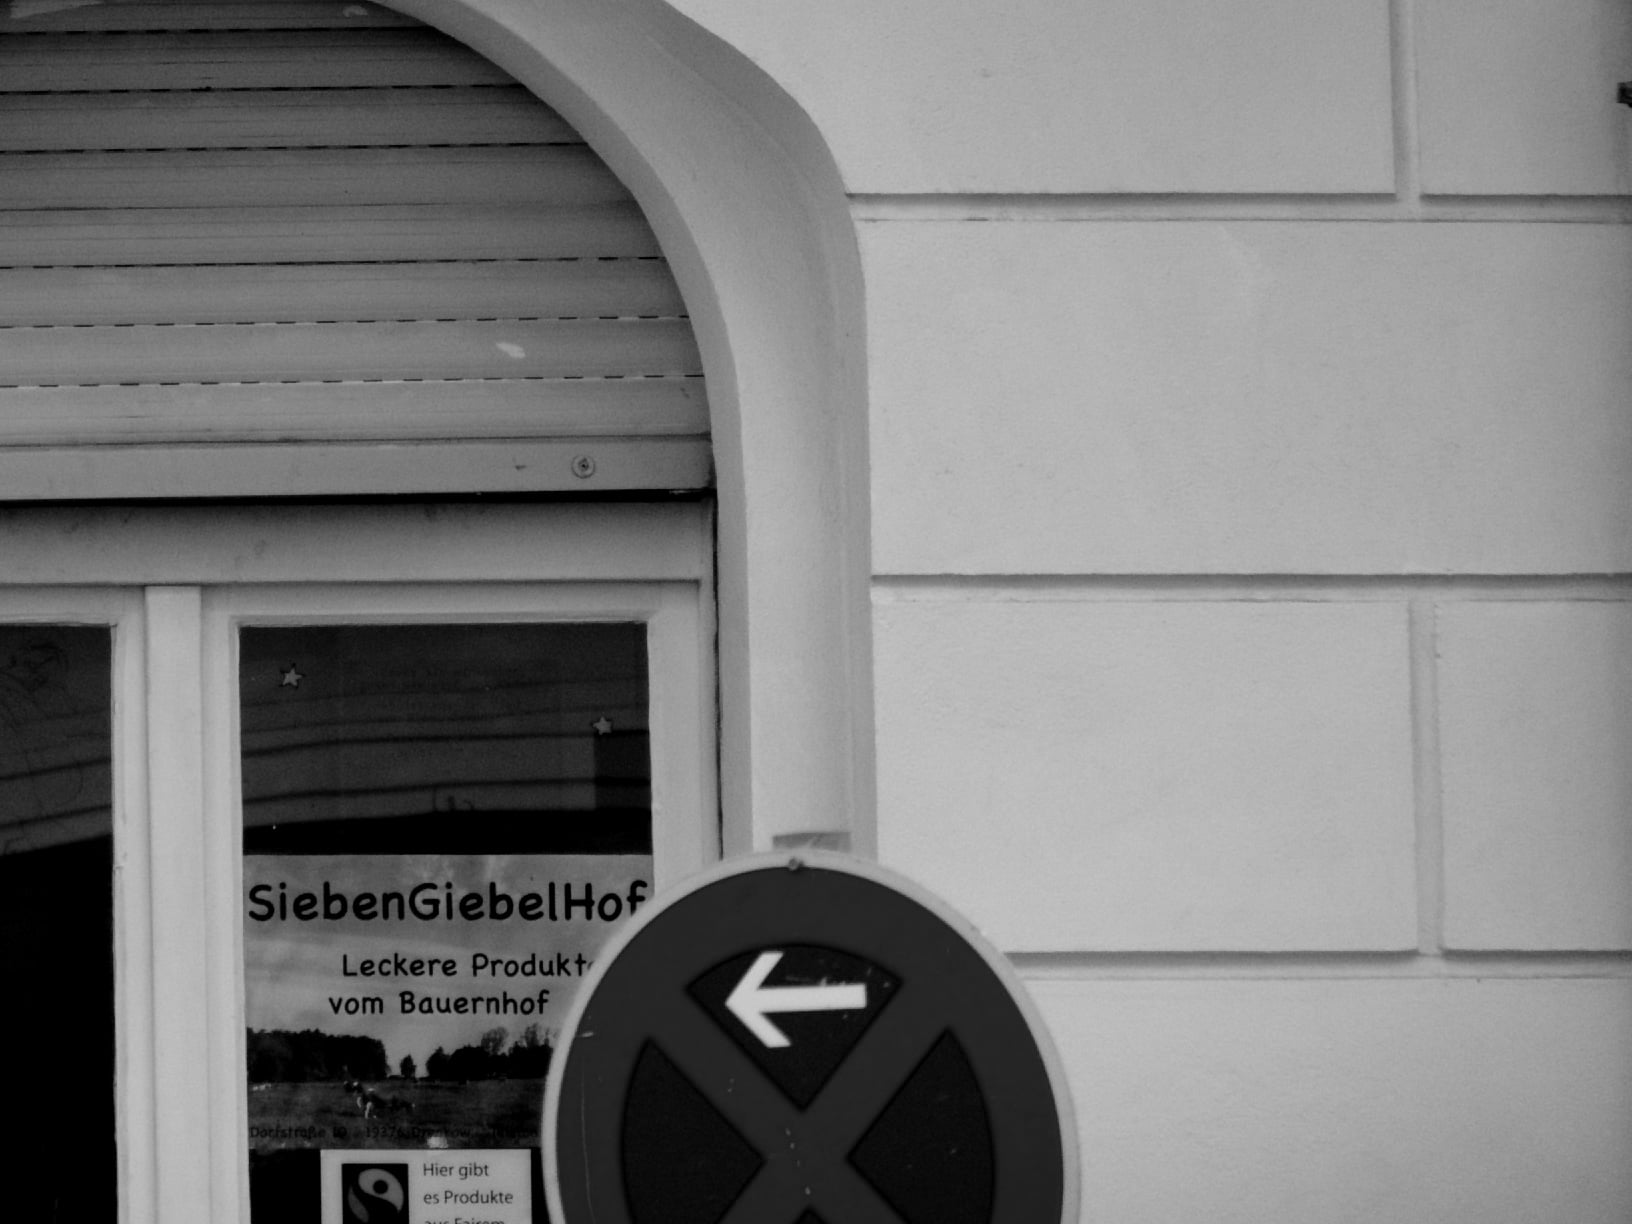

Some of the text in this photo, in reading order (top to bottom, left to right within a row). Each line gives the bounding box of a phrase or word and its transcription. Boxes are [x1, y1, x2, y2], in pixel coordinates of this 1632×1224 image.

[248, 881, 648, 922] SiebenGiebelHof
[342, 953, 595, 978] Leckere Produkt
[328, 989, 550, 1016] vom Bauernhof
[423, 1162, 490, 1181] Hier gibt
[423, 1190, 515, 1205] es Produkte
